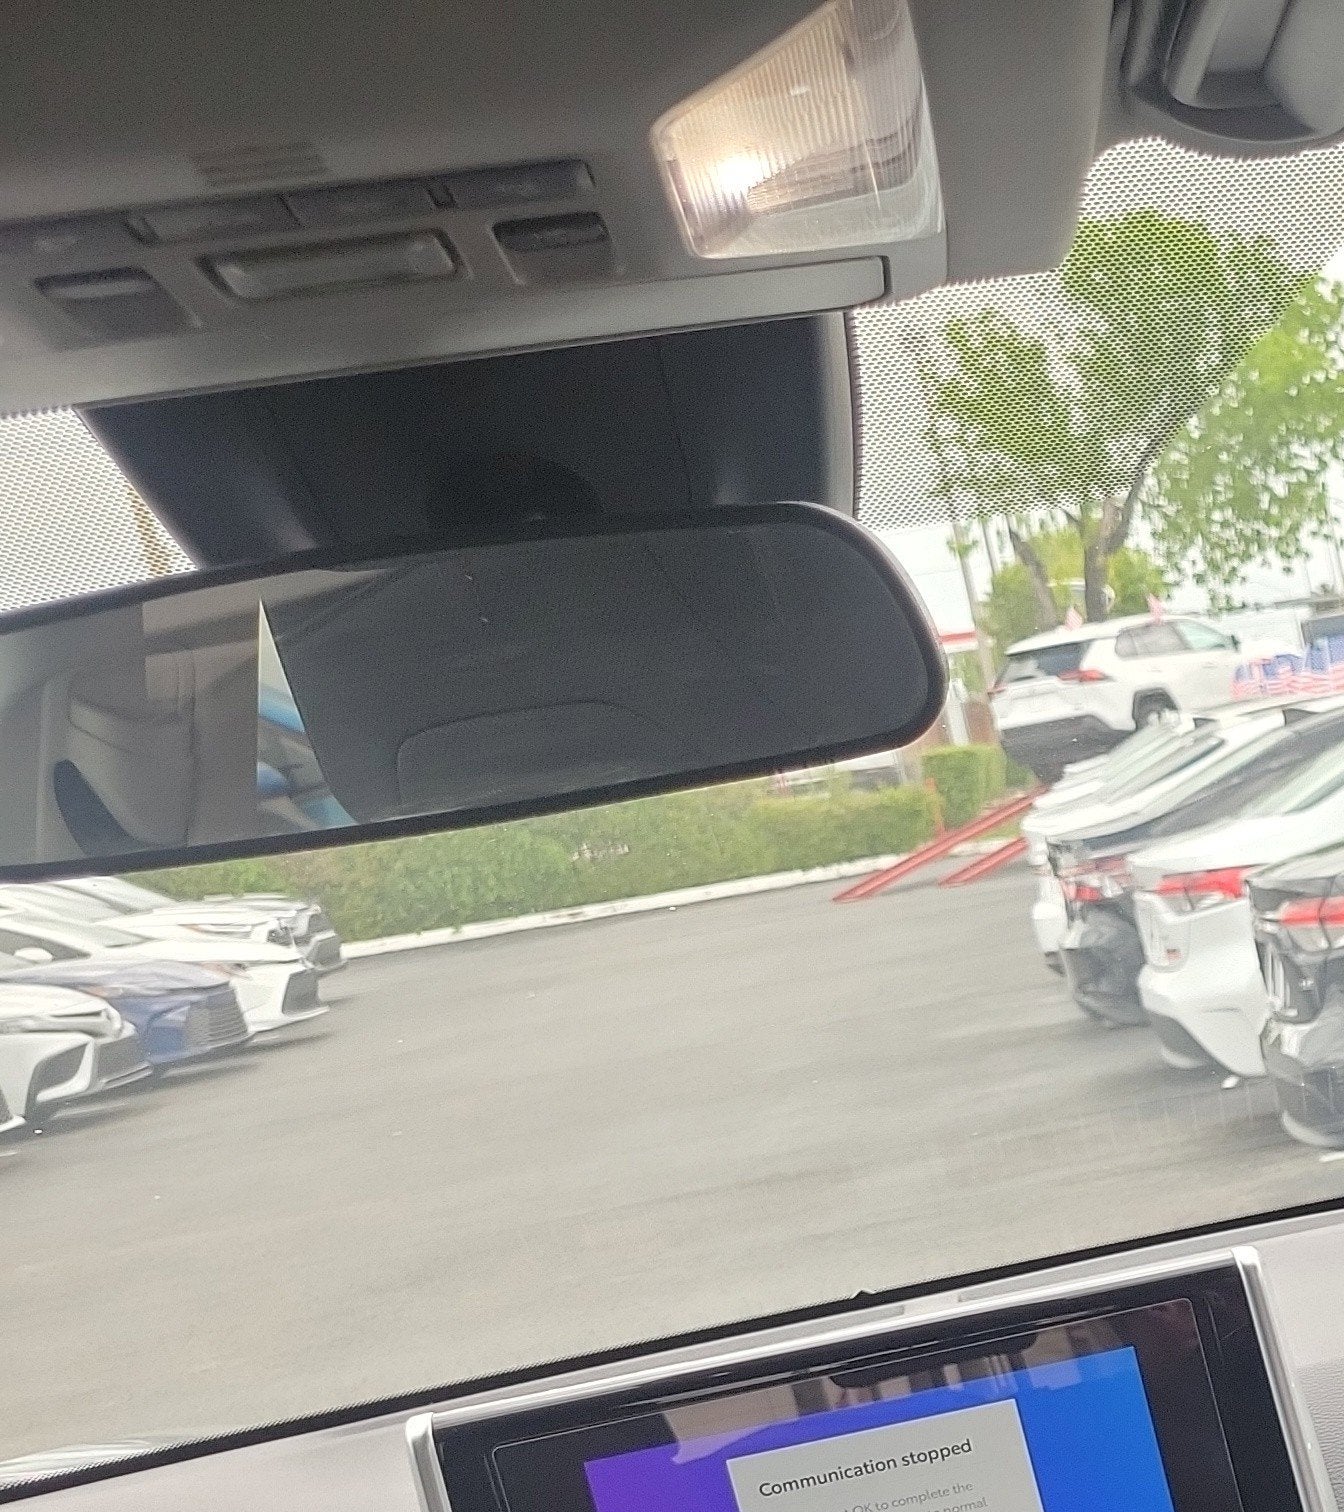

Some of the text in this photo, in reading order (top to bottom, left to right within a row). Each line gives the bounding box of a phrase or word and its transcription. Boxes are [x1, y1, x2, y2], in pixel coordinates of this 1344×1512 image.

[758, 1438, 973, 1498] Communication stopped
[874, 1500, 889, 1512] to
[891, 1486, 950, 1511] complete
[952, 1481, 974, 1496] the
